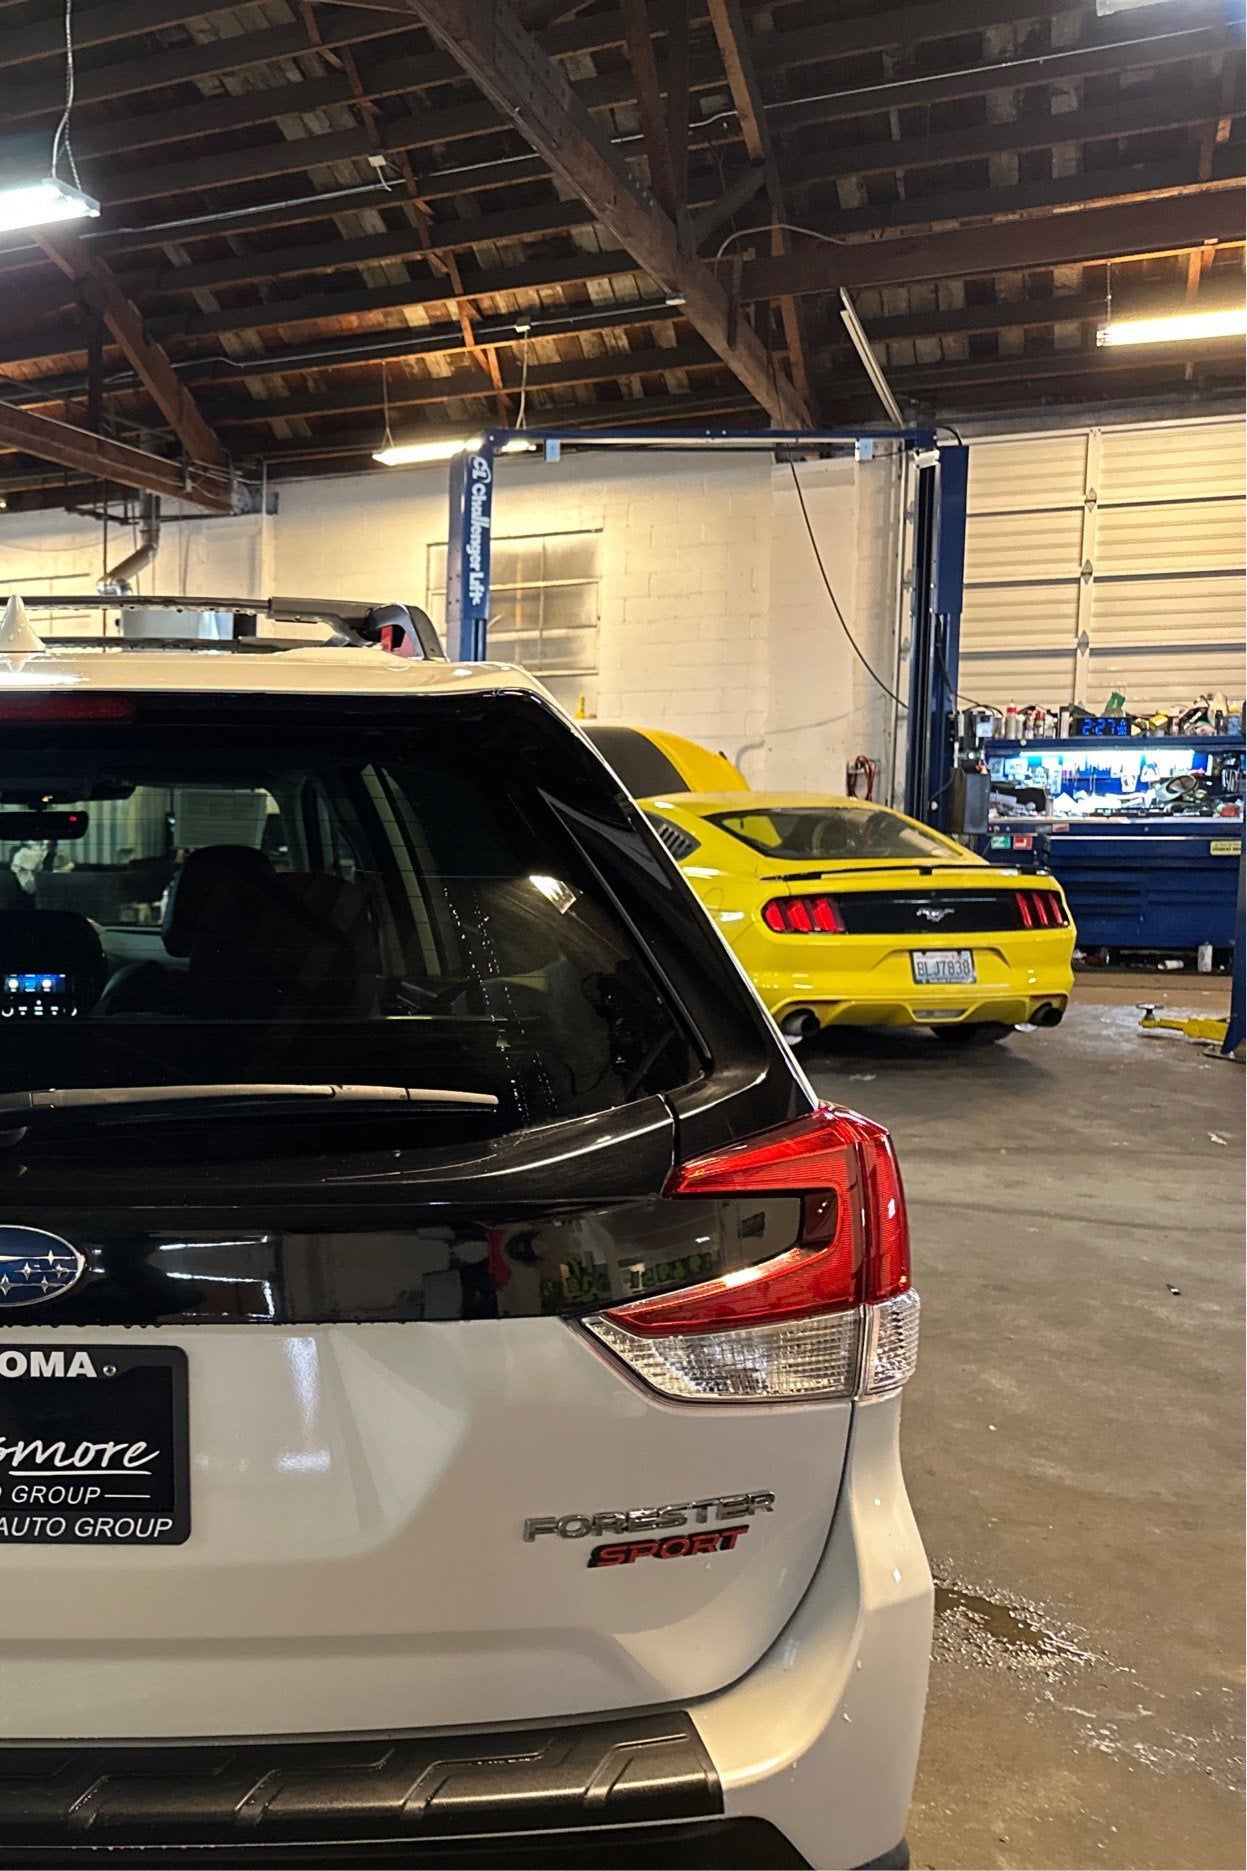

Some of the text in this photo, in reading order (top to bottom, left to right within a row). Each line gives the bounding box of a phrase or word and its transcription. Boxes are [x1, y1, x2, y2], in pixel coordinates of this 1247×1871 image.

[466, 483, 490, 571] Challenger
[917, 960, 970, 977] BLJ7838
[11, 1485, 102, 1505] GROUP
[73, 1516, 173, 1538] GROUP
[522, 1490, 776, 1543] FORESTER
[587, 1524, 750, 1568] SPORT
